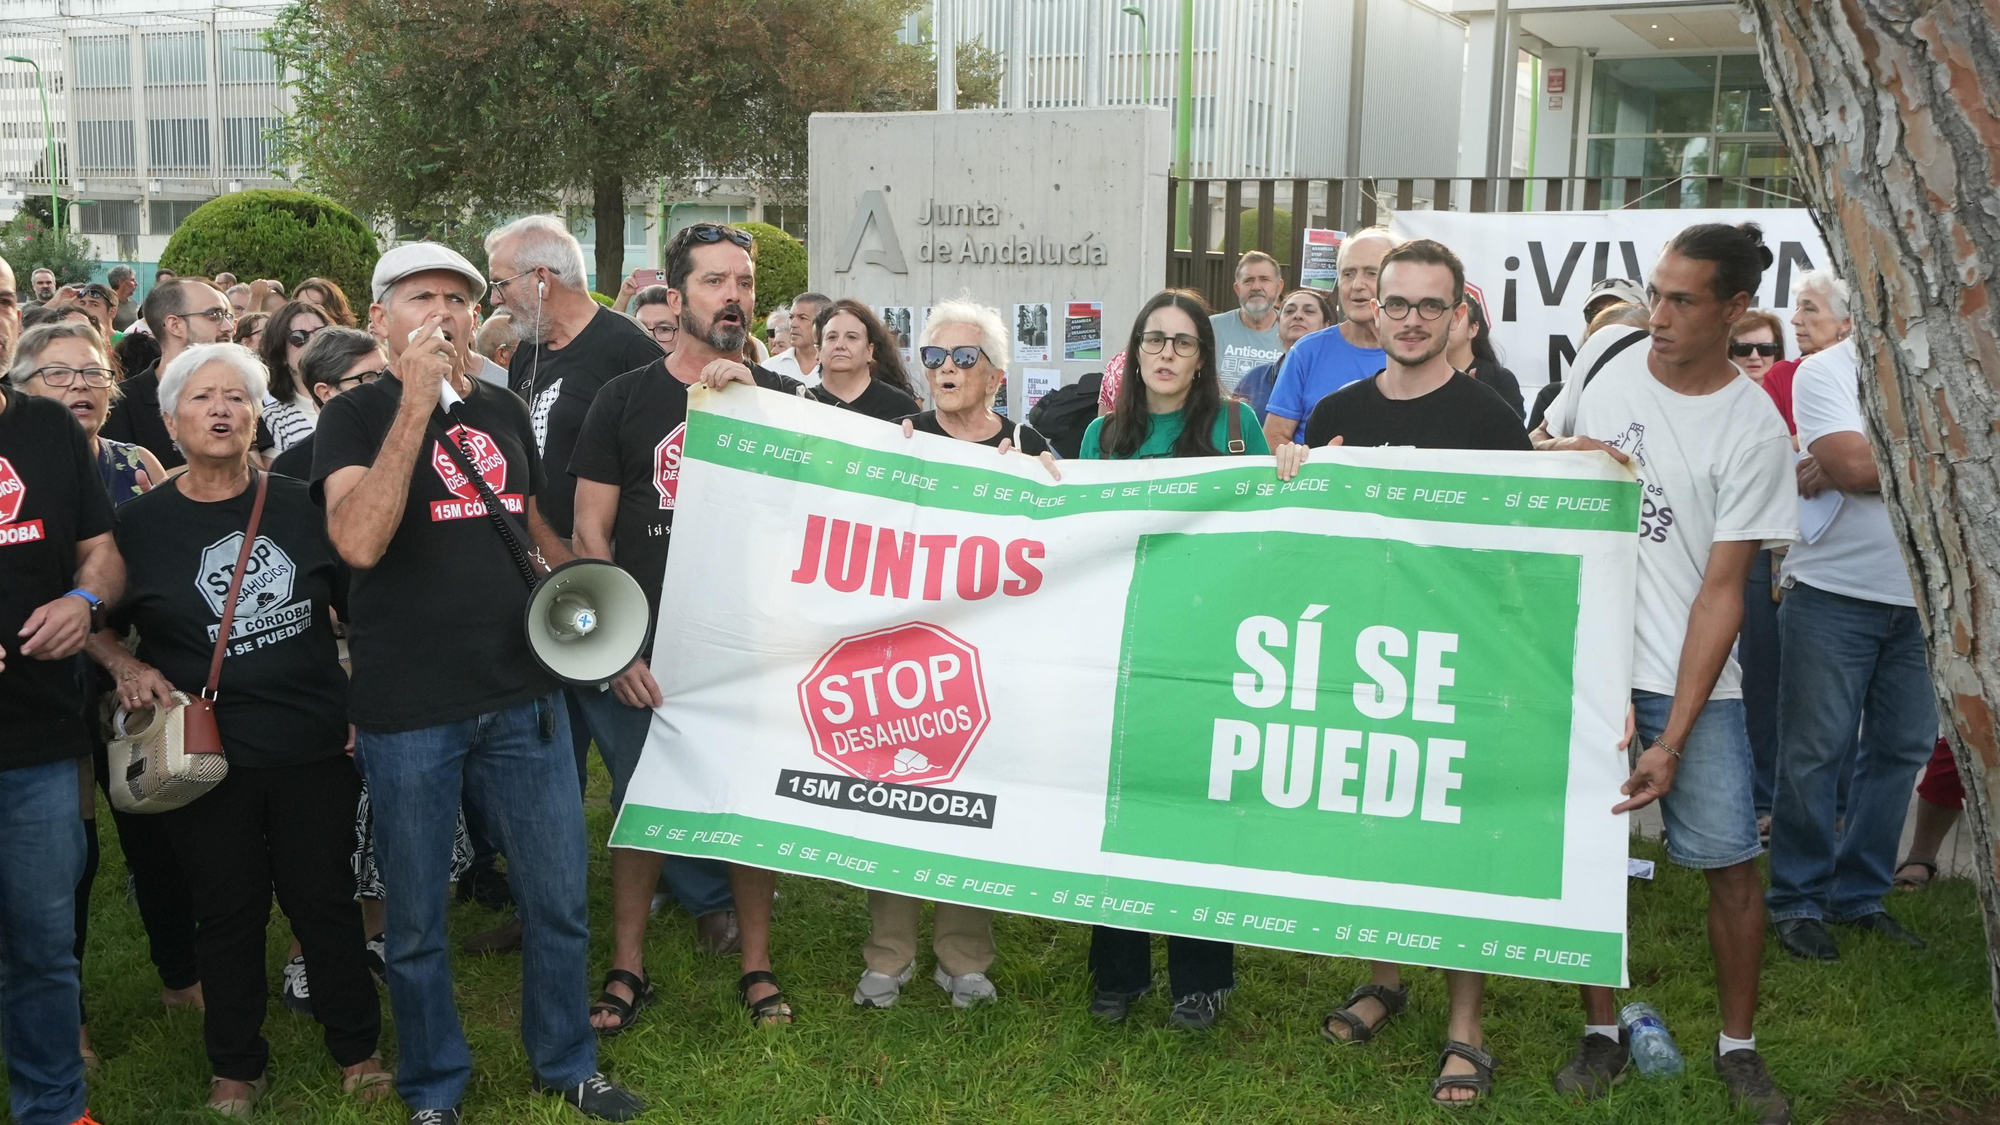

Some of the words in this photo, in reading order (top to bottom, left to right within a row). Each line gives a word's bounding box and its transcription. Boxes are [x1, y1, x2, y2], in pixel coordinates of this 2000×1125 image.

[917, 198, 1000, 227] Junta
[917, 232, 952, 264] de
[958, 231, 1108, 266] Andalucía
[437, 435, 487, 475] SOP
[717, 431, 732, 448] SÍ
[737, 438, 757, 454] SE
[763, 444, 813, 465] PUEDE
[845, 458, 862, 475] SÍ
[866, 465, 886, 480] SE
[892, 470, 938, 491] PUEDE
[973, 481, 990, 497] SÍ
[994, 487, 1014, 502] SE
[1019, 490, 1066, 508] PUEDE
[1101, 485, 1117, 499] SÍ
[1121, 486, 1141, 497] SE
[1147, 481, 1198, 496] PUEDE
[1235, 479, 1251, 496] SÍ
[1256, 483, 1275, 497] SE
[1280, 478, 1330, 494] PUEDE
[1365, 483, 1382, 499] SÍ
[1387, 486, 1406, 501] SE
[1413, 488, 1467, 504] PUEDE
[1505, 490, 1522, 508] SÍ
[1528, 495, 1549, 509] SE
[1556, 496, 1612, 512] PUEDE
[435, 503, 462, 519] 15M
[0, 525, 40, 544] DOBA
[791, 514, 1046, 601] JUNTOS
[210, 625, 238, 641] 1M
[245, 604, 310, 633] CÓRDOBA
[234, 641, 254, 656] SE
[1232, 603, 1331, 712] SÍ
[1352, 625, 1459, 724] SE
[818, 653, 961, 724] STOP
[831, 704, 972, 756] DESAHUCIOS
[1207, 717, 1466, 825] PUEDE
[788, 776, 841, 801] 15M
[848, 783, 988, 820] CÓRDOBA
[645, 823, 663, 837] SÍ
[666, 828, 687, 842] SE
[692, 831, 743, 847] PUEDE
[777, 840, 796, 856] SÍ
[799, 846, 820, 861] SE
[825, 851, 878, 874] PUEDE
[913, 867, 931, 883] SÍ
[936, 873, 957, 888] SE
[962, 878, 1015, 897] PUEDE
[1052, 887, 1070, 904] SÍ
[1074, 893, 1095, 908] SE
[1101, 896, 1155, 915] PUEDE
[1192, 905, 1210, 922] SÍ
[1215, 911, 1235, 926] SE
[1242, 914, 1297, 934] PUEDE
[1335, 923, 1353, 940] SÍ
[1357, 928, 1378, 943] SE
[1385, 931, 1442, 950] PUEDE
[1481, 939, 1499, 956] SÍ
[1505, 945, 1526, 960] SE
[1534, 948, 1592, 967] PUEDE
